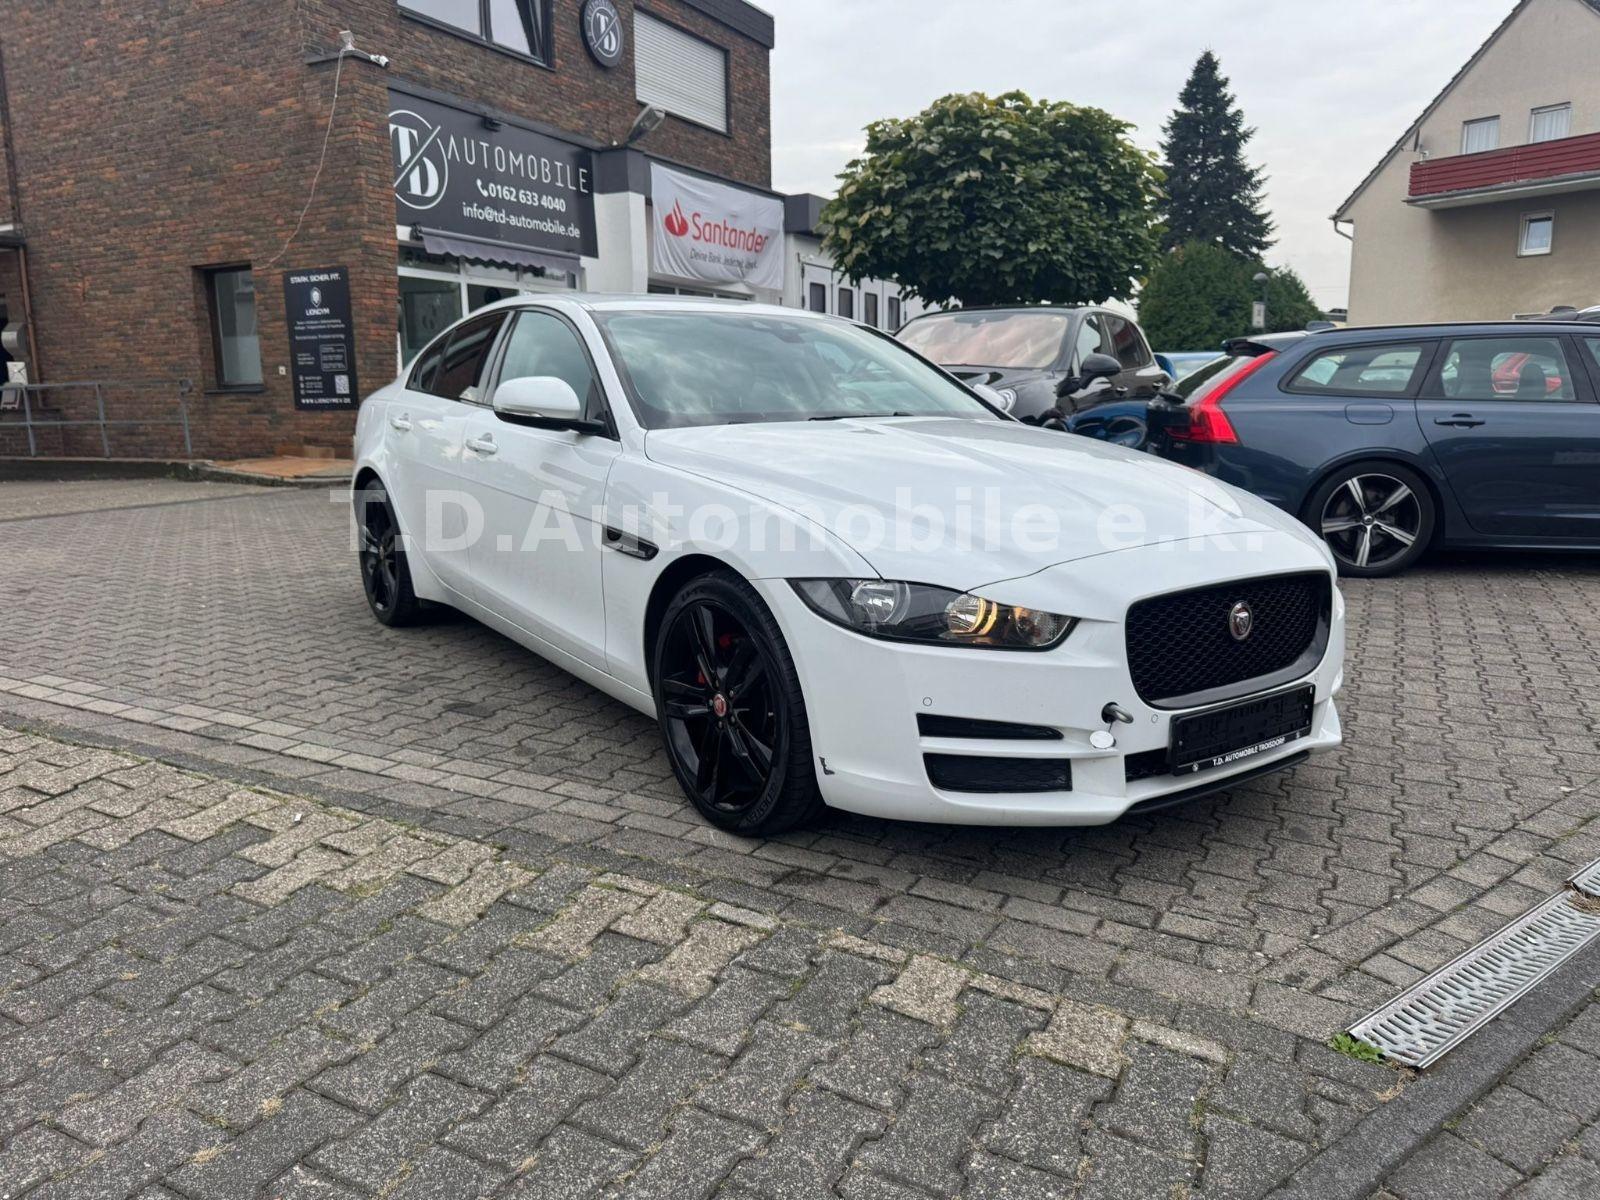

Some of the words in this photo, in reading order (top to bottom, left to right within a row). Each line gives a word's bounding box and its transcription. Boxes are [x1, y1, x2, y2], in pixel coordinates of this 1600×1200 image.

[447, 133, 589, 194] AUTOMOBILE
[488, 182, 517, 203] 0162
[518, 189, 539, 207] 633
[540, 194, 567, 213] 4040
[462, 201, 581, 239] info@td-automobile.de
[691, 212, 770, 254] Santander
[1225, 746, 1259, 763] AUTOMOBILE
[1258, 736, 1286, 753] TROISDORF
